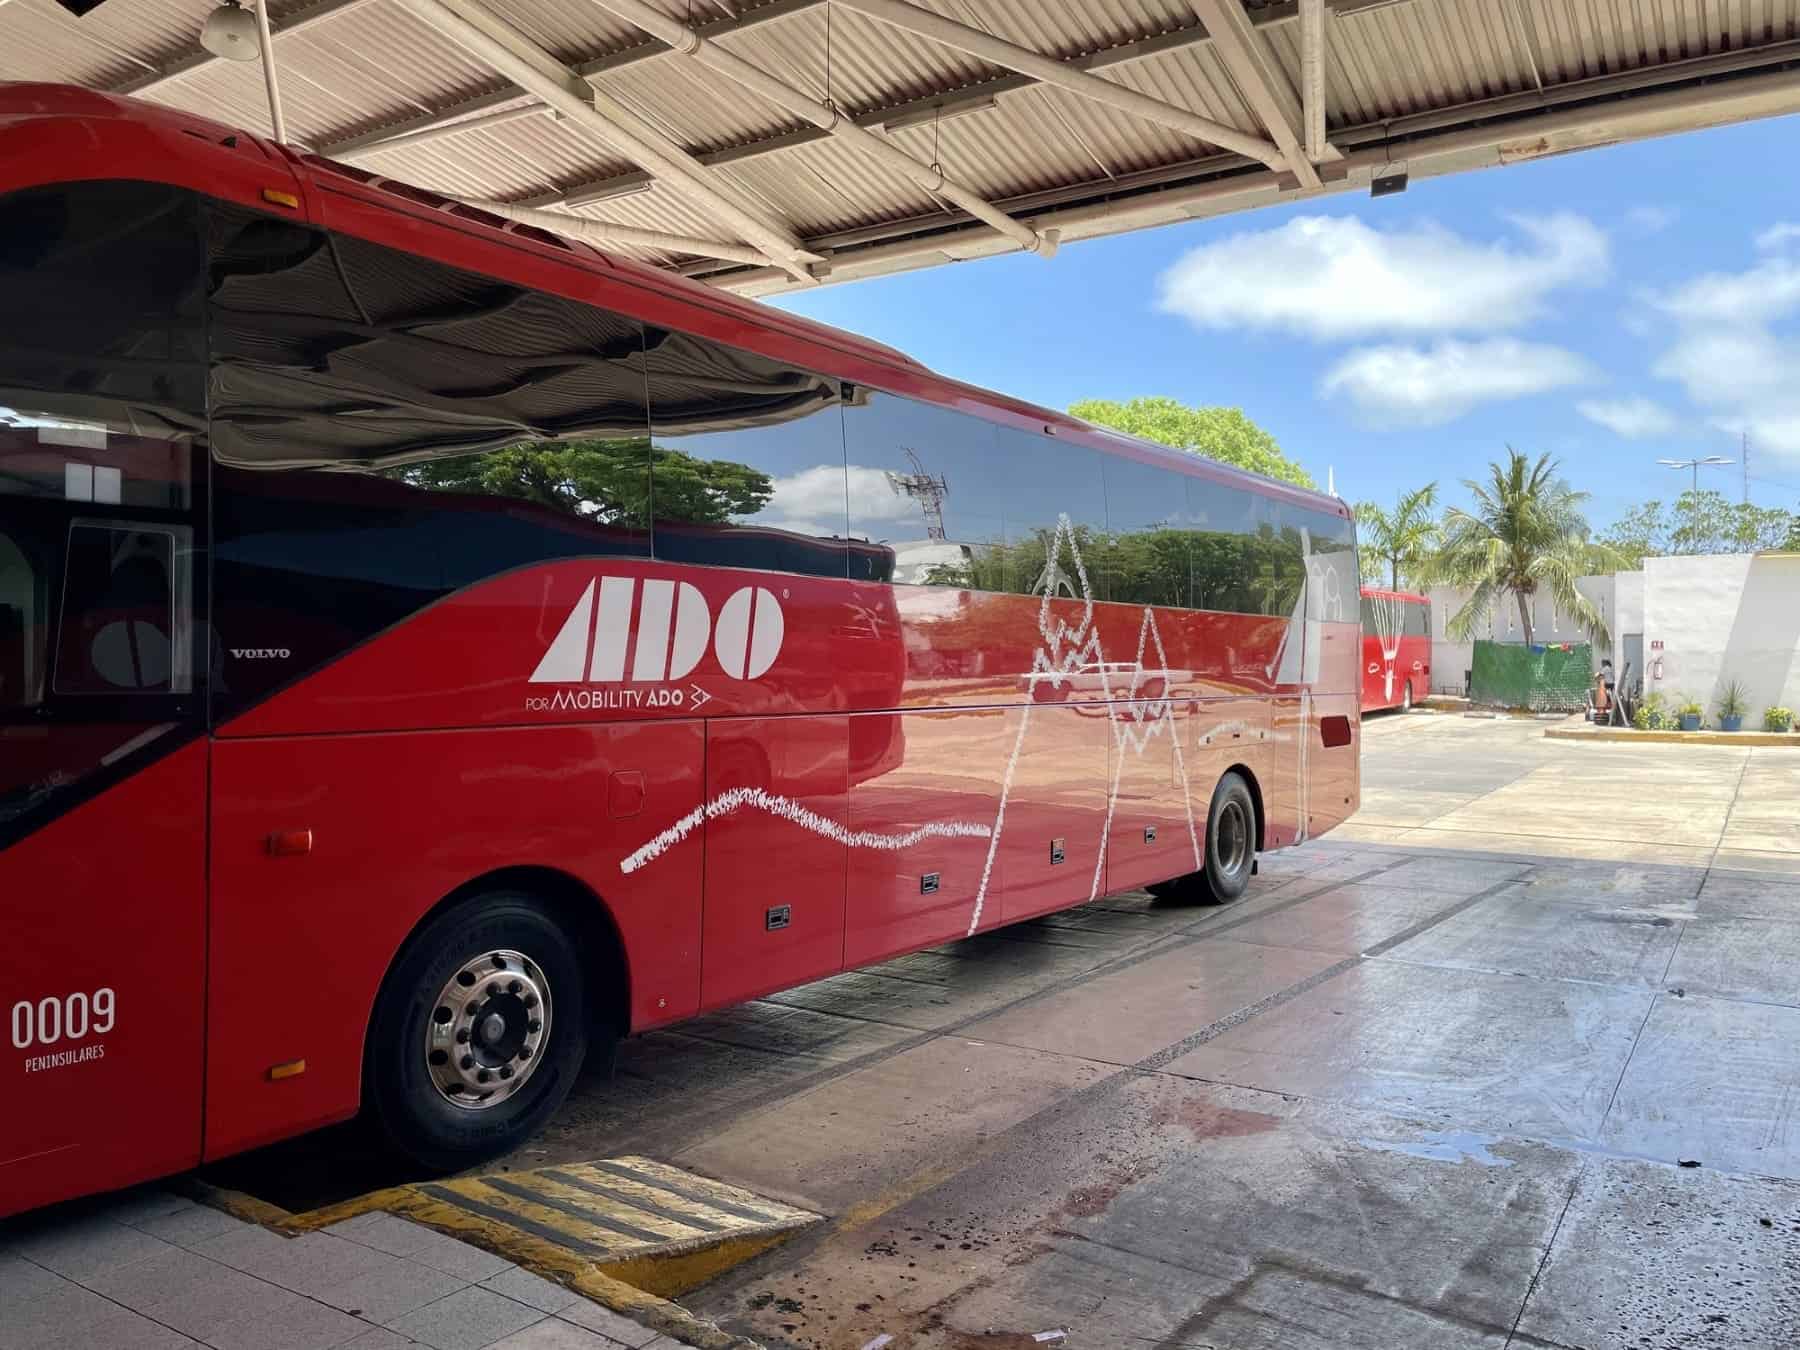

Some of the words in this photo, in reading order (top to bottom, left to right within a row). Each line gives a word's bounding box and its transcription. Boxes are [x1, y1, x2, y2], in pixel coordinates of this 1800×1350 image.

[528, 576, 784, 683] ADO
[229, 648, 291, 659] VOLVO
[526, 698, 549, 711] POR
[550, 689, 643, 710] MOBILITY
[646, 689, 683, 707] ADO
[11, 987, 115, 1049] 0009
[25, 1044, 105, 1073] PENINSULARES
